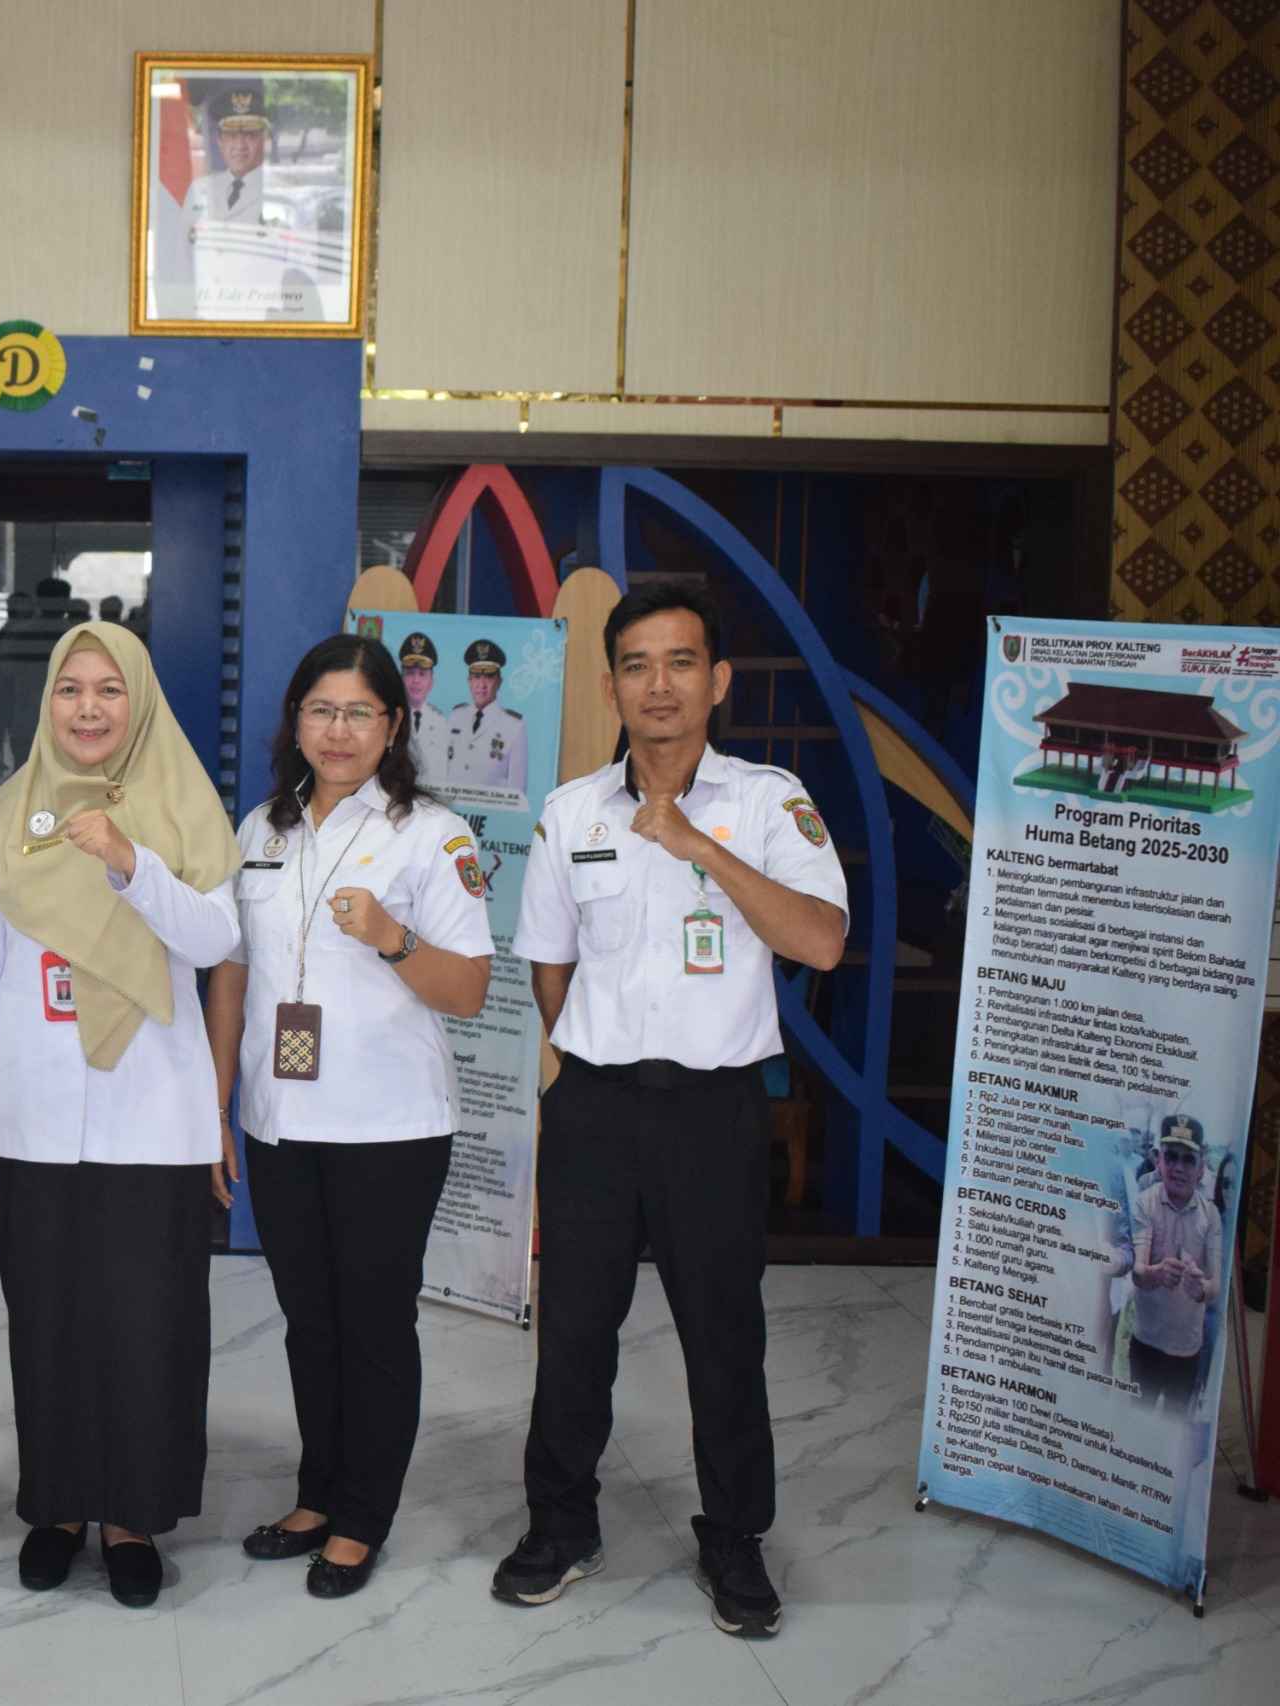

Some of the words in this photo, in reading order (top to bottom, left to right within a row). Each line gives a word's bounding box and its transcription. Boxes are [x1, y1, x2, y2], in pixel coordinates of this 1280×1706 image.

[1031, 638, 1084, 648] DISLUTKAN
[1085, 640, 1113, 650] PROV.
[1116, 642, 1161, 653] KALTENG
[1054, 802, 1124, 827] Program
[1128, 810, 1202, 836] Prioritas
[1024, 823, 1075, 845] Huma
[1079, 829, 1137, 857] Betang
[1140, 837, 1229, 864] 2025-2030
[986, 847, 1045, 866] KALTENG
[1047, 855, 1119, 876] bermartabat
[976, 965, 1028, 985] BETANG
[1030, 974, 1066, 991] MAJU
[967, 1070, 1021, 1090] BETANG
[1024, 1079, 1078, 1102] MAKMUR
[956, 1186, 1012, 1207] BETANG
[1014, 1197, 1066, 1220] CERDAS
[948, 1275, 1004, 1297] BETANG
[1007, 1287, 1048, 1308] SEHAT
[940, 1363, 996, 1386] BETANG
[999, 1376, 1057, 1404] HARMONI
